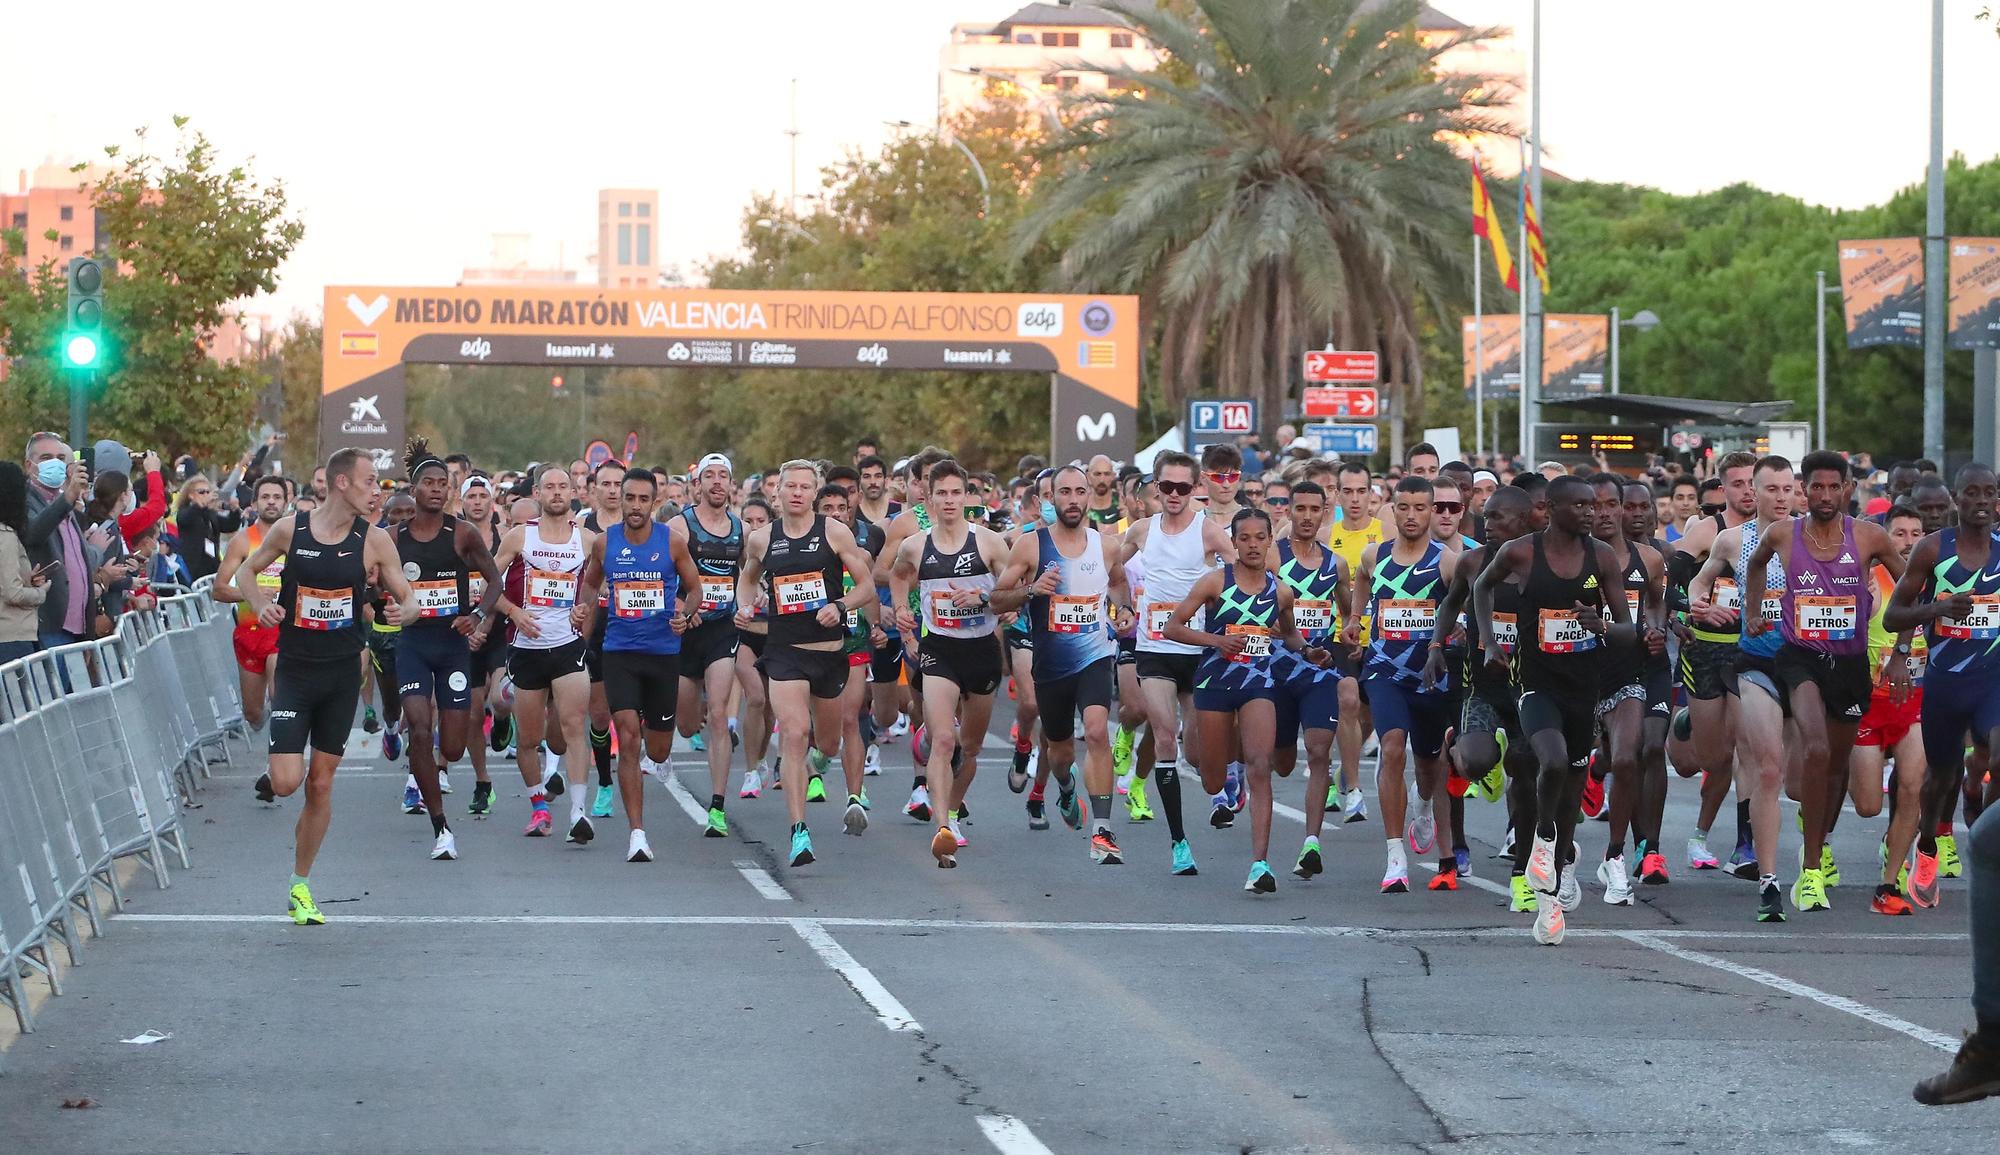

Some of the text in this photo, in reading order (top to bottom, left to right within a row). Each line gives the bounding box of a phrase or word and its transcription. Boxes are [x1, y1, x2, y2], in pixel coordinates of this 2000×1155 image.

[395, 293, 1013, 333] MEDIO MARATÓN VALENCIA TRINIDAD ALFONSO
[1024, 308, 1057, 332] edp
[460, 337, 492, 360] edp
[856, 343, 889, 366] edp
[1199, 407, 1214, 428] P
[1224, 407, 1249, 428] 1A
[341, 422, 388, 433] CaixaBank
[1355, 429, 1373, 451] 14
[532, 550, 577, 559] BORDEAUX
[436, 570, 457, 578] FOCUS
[612, 571, 627, 579] team
[547, 580, 558, 588] 99
[1831, 576, 1859, 584] VIACTIV
[793, 583, 804, 592] 42
[428, 590, 439, 598] 45
[543, 588, 565, 598] Fifou
[632, 590, 647, 598] 106
[705, 592, 727, 604] Diego
[786, 590, 820, 603] WAGELI
[319, 600, 331, 609] 62
[426, 596, 458, 607] BLANCO
[627, 599, 656, 608] SAMIR
[309, 608, 346, 619] DOUMA
[937, 606, 985, 617] DE BACKER
[1072, 605, 1084, 613] 46
[1302, 609, 1317, 617] 193
[1401, 609, 1412, 618] 24
[1820, 607, 1832, 616] 19
[1060, 612, 1097, 624] DE LEÓN
[1295, 618, 1323, 628] PACER
[1808, 618, 1849, 628] PETROS
[1384, 619, 1435, 628] BEN DAOUD
[1565, 620, 1577, 629] 70
[1555, 629, 1587, 641] PACER
